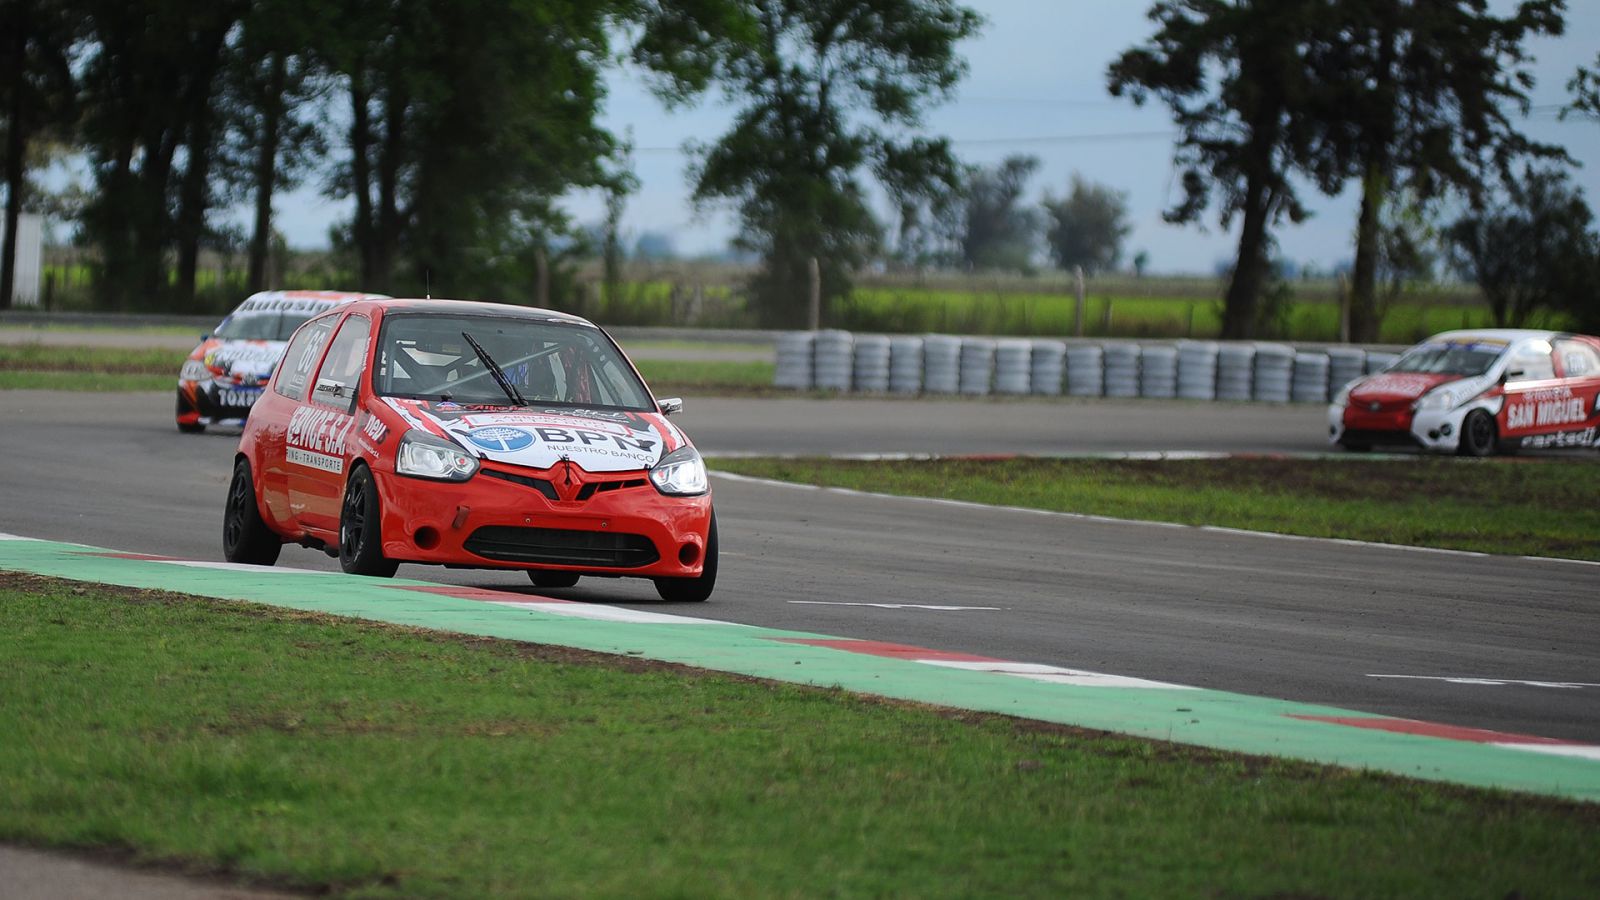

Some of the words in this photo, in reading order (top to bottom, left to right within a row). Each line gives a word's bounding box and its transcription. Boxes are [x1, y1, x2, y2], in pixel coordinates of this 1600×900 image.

[1507, 403, 1535, 430] SAN
[1536, 397, 1587, 426] MIGUEL
[535, 428, 654, 453] BPN
[547, 444, 608, 456] NUESTRO
[611, 450, 655, 463] BANCO
